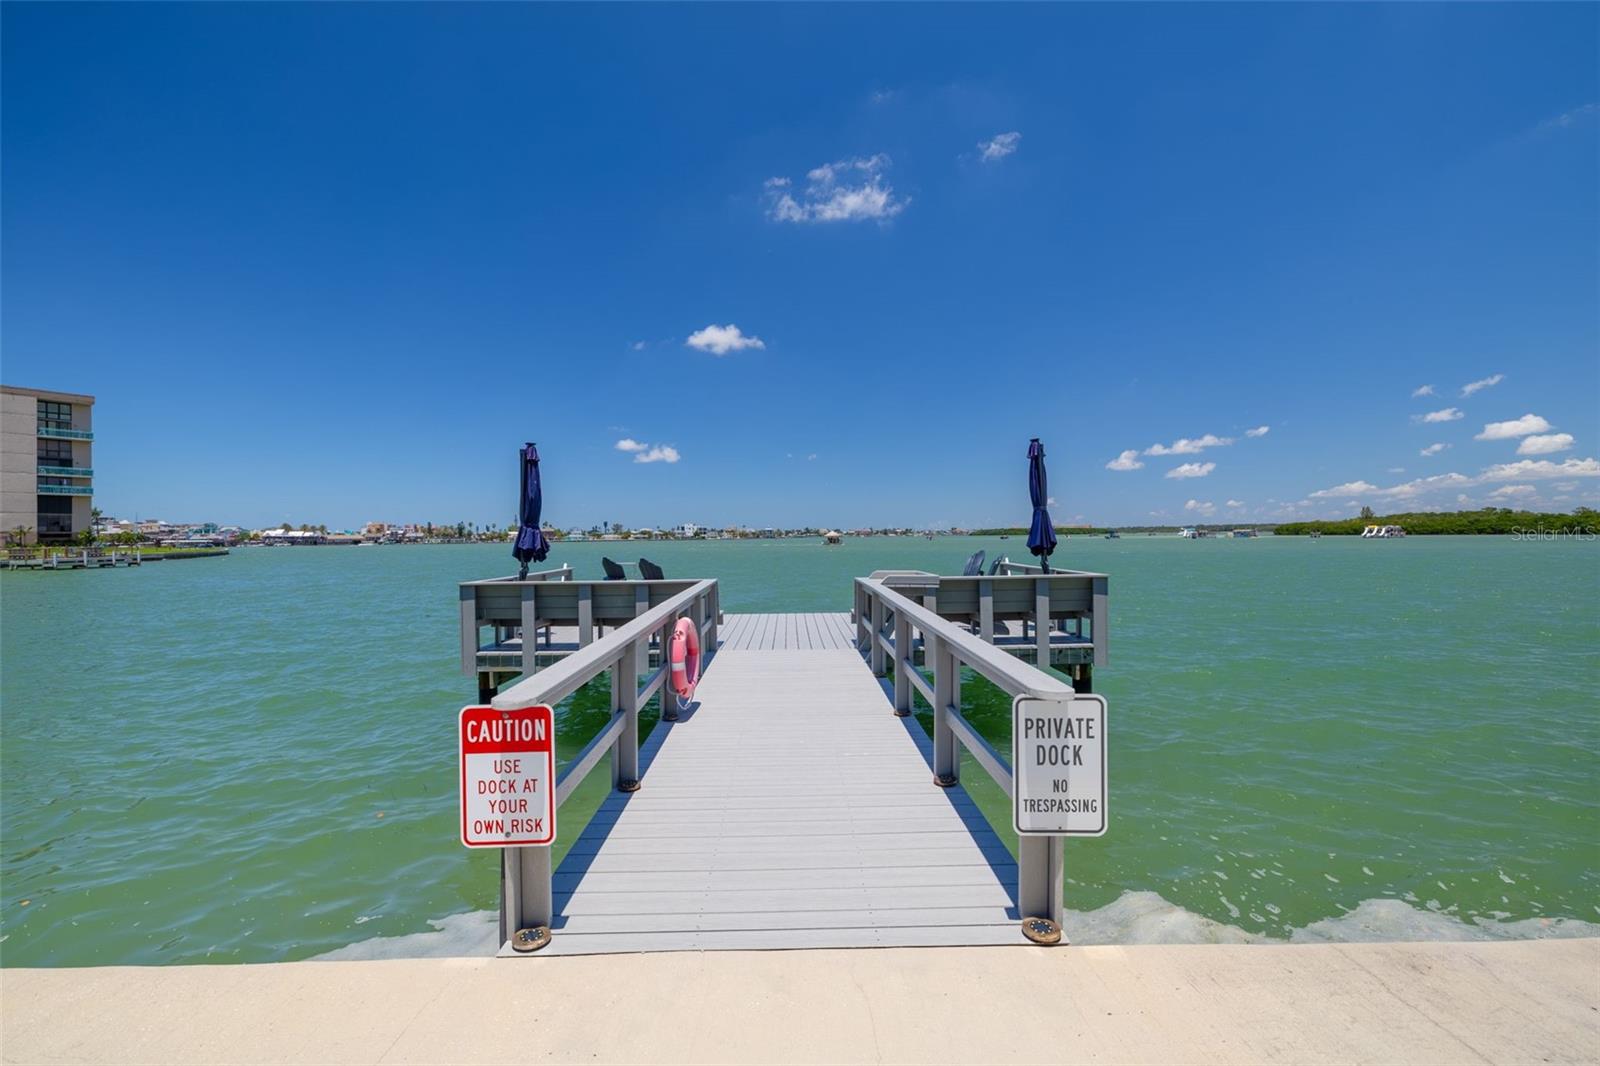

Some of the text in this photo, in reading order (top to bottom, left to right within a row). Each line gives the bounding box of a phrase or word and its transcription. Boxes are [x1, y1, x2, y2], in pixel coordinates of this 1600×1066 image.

[467, 719, 546, 743] CAUTION
[1024, 718, 1095, 739] PRIVATE
[1036, 745, 1083, 766] DOCK
[494, 759, 521, 774] USE
[478, 779, 538, 794] DOCK AT
[1052, 779, 1068, 793] NO
[489, 799, 528, 814] YOUR
[1023, 799, 1097, 813] TRESPASSING
[474, 818, 543, 834] OWN RISK
